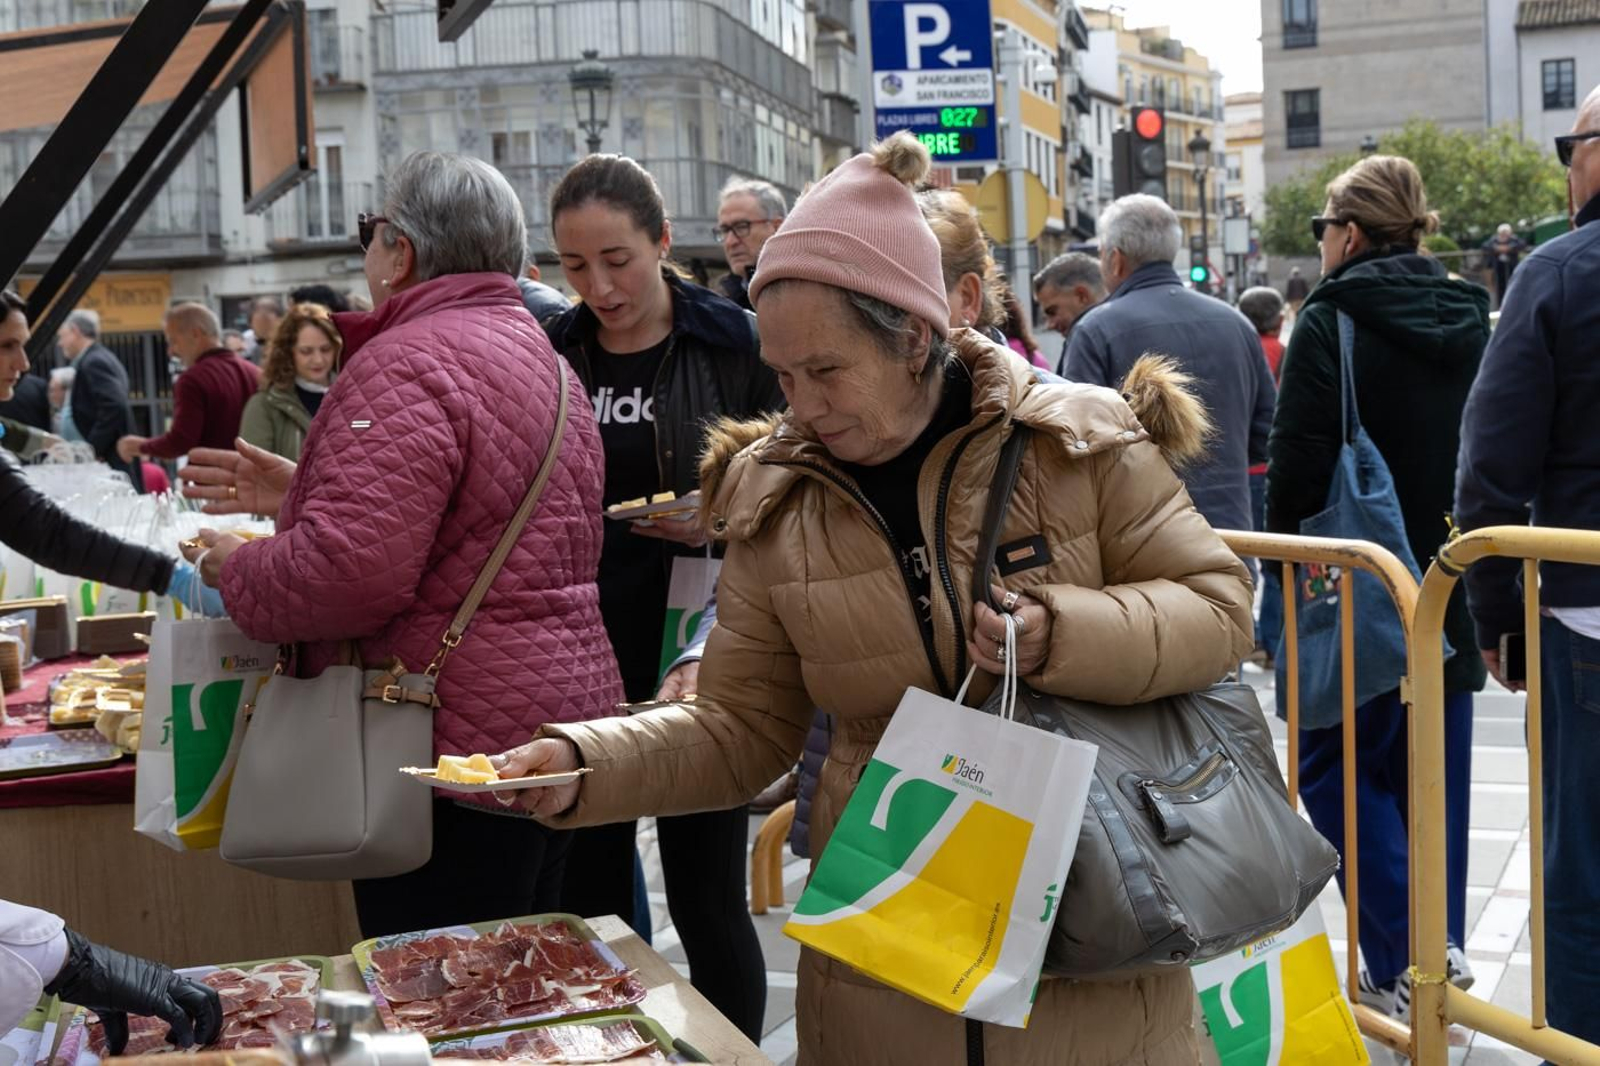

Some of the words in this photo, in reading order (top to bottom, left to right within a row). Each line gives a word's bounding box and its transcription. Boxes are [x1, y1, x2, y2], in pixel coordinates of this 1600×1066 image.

[903, 3, 951, 69] P
[917, 73, 988, 85] APARCAMIENTO
[917, 91, 935, 101] SAN
[938, 89, 990, 100] FRANCISCO
[941, 108, 978, 128] 027
[918, 132, 961, 155] IBRE
[954, 758, 985, 784] Jaén
